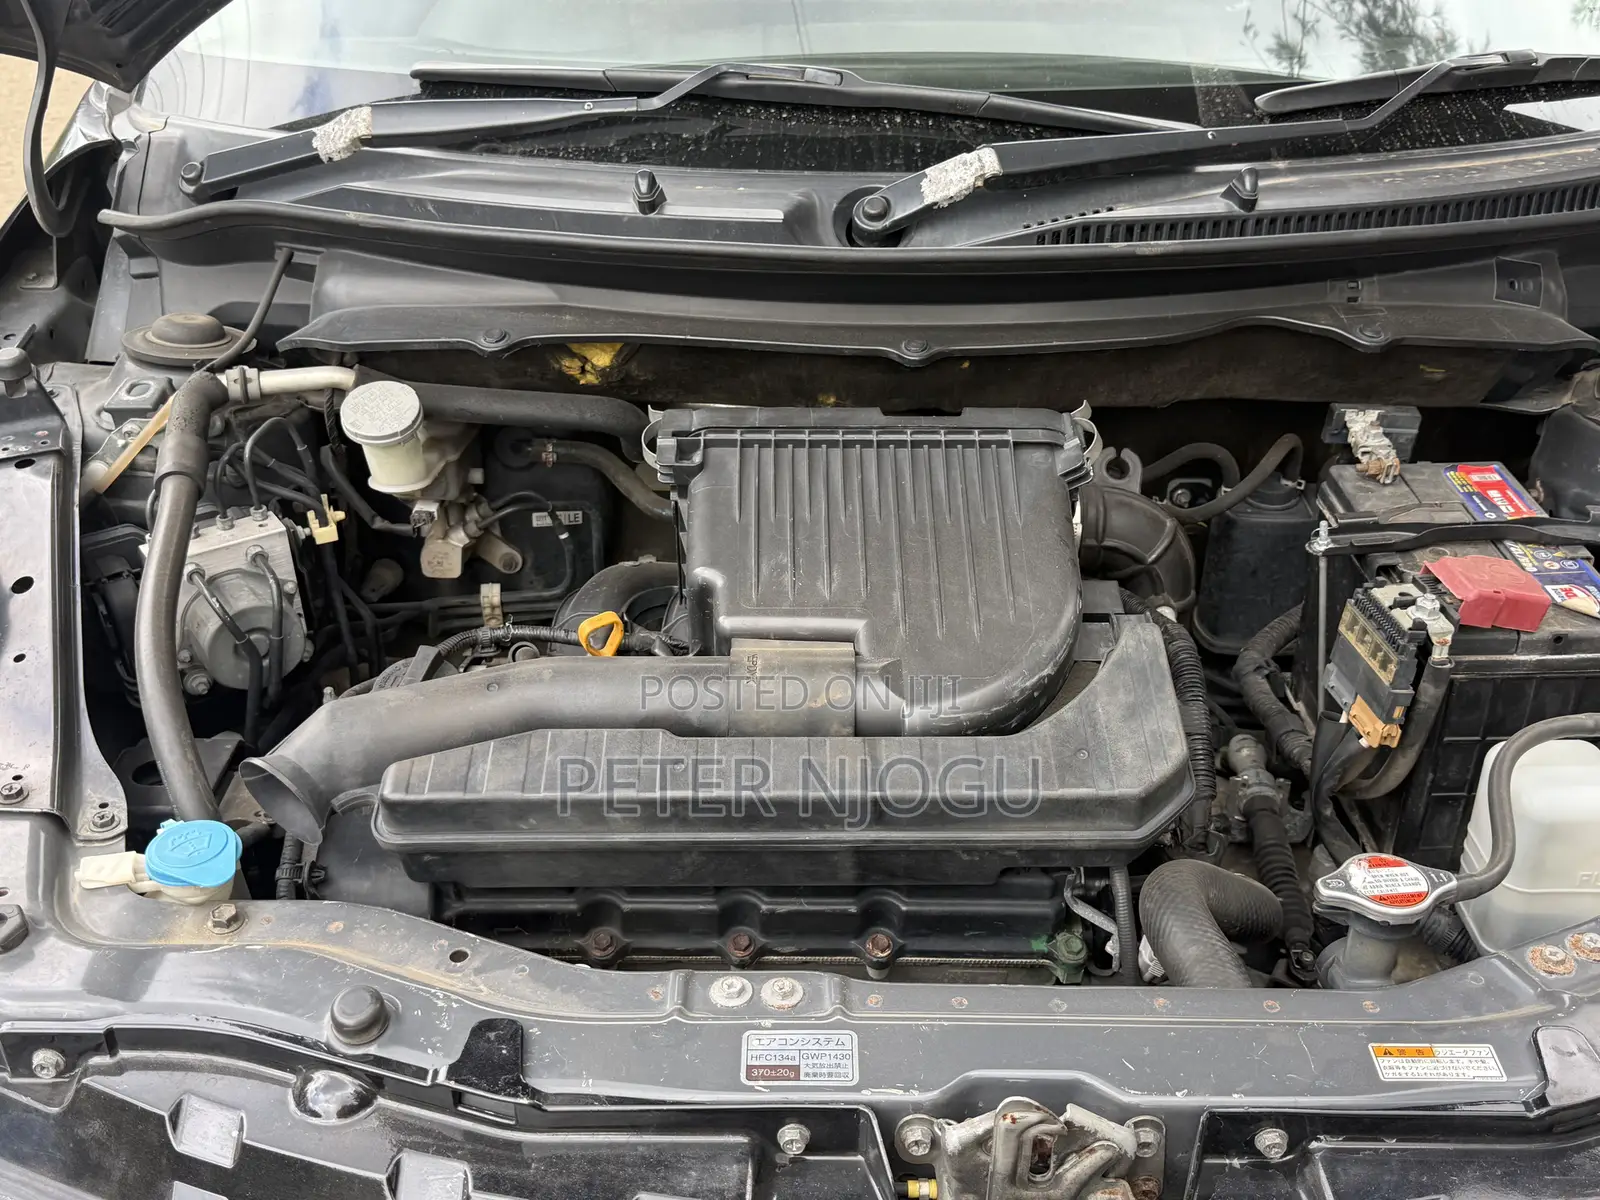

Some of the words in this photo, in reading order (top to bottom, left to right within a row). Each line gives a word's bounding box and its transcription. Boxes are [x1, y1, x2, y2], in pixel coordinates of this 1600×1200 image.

[753, 1037, 846, 1047] エアコンシステム
[750, 1053, 797, 1062] HFC134a
[801, 1052, 851, 1061] GWP1430
[751, 1068, 795, 1078] 370±20g
